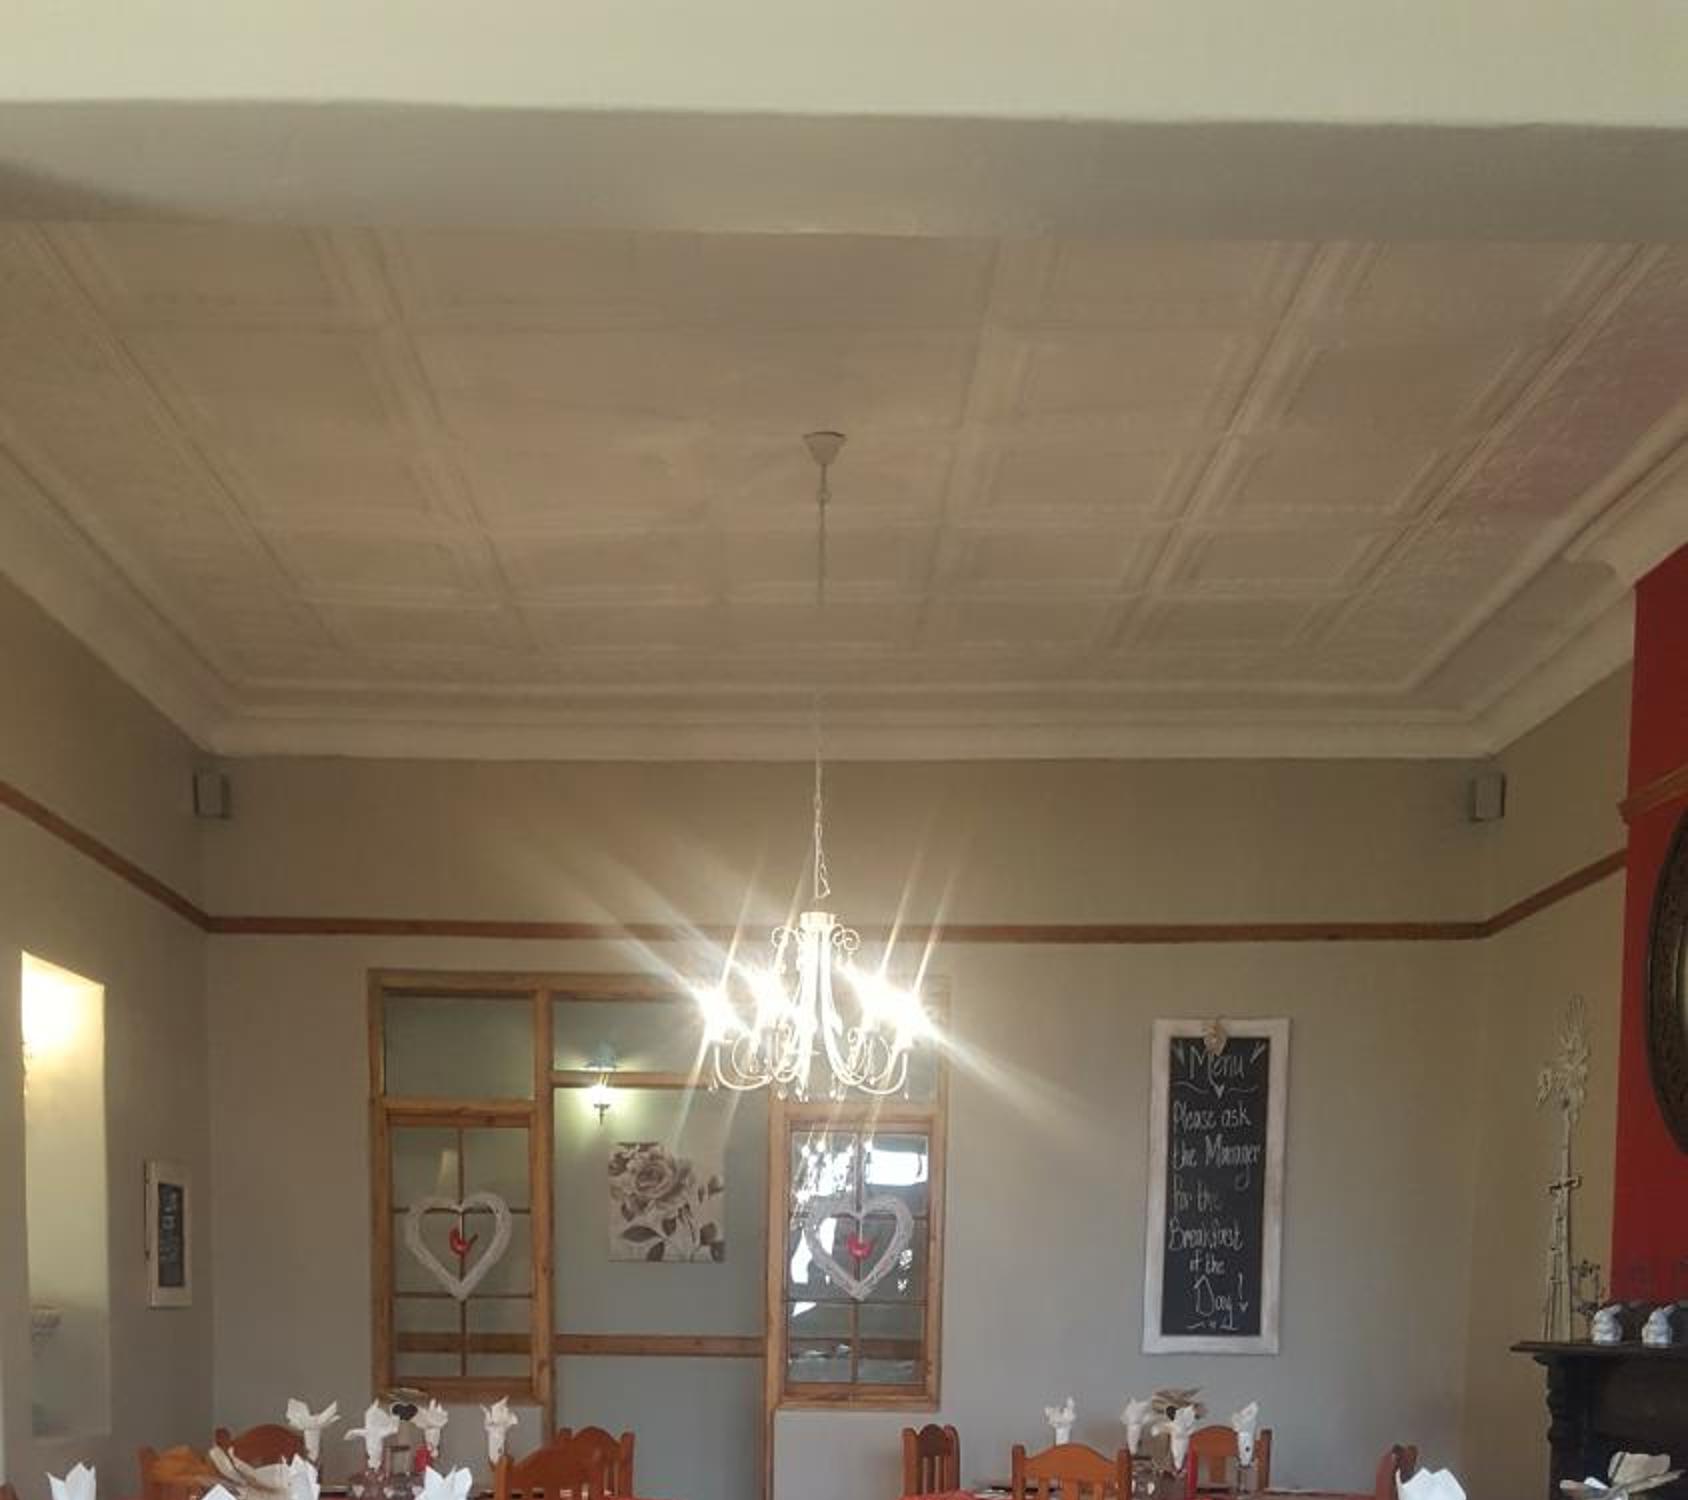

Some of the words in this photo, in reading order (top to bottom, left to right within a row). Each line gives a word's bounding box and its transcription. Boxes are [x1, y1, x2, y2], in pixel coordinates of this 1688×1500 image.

[1189, 1044, 1245, 1081] Menu
[1174, 1102, 1217, 1131] Please
[1221, 1104, 1252, 1128] ask
[1204, 1134, 1261, 1189] Manager
[1168, 1216, 1244, 1251] Breakfast
